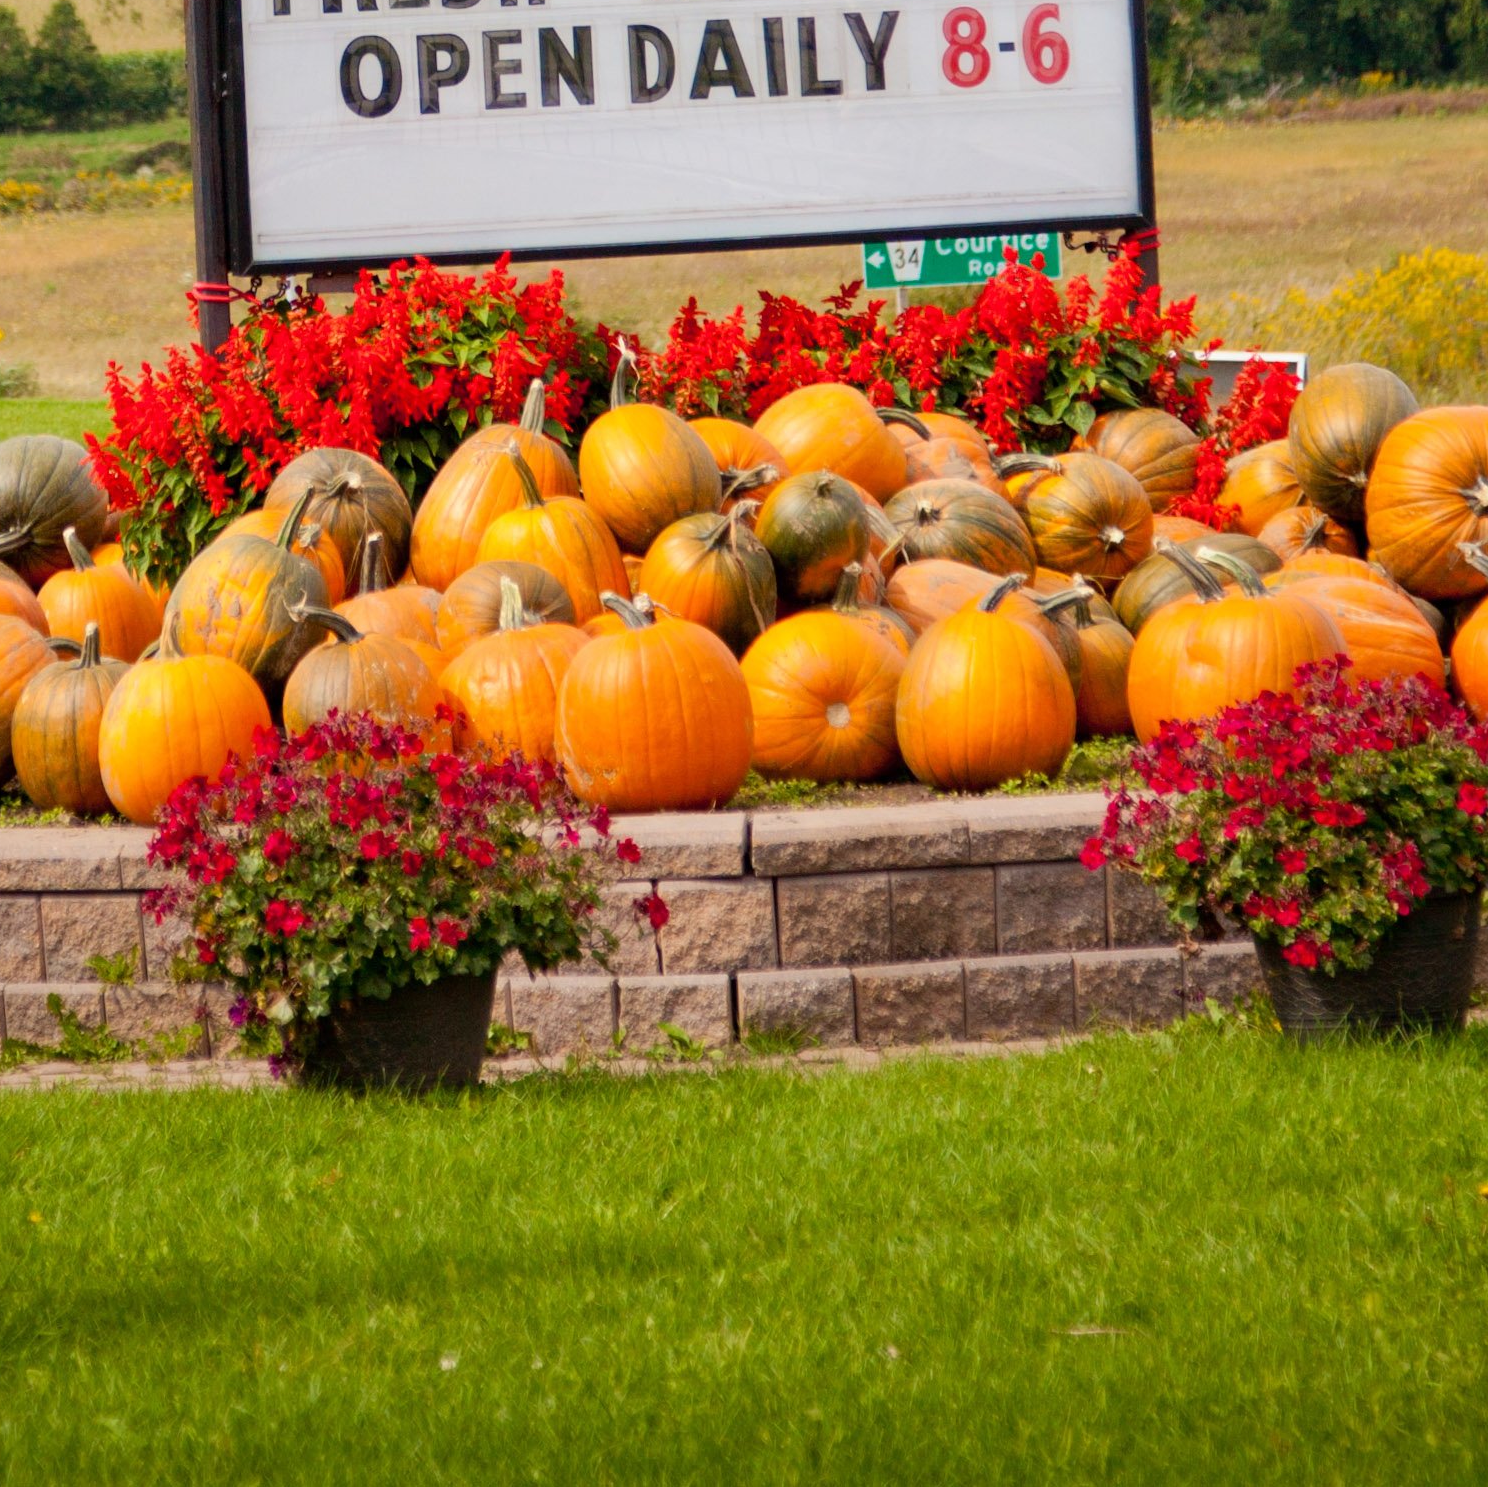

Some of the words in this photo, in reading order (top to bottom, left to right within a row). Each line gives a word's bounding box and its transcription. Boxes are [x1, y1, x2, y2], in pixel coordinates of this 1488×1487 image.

[339, 25, 595, 119] OPEN
[628, 11, 900, 104] DAILY
[942, 3, 1070, 88] 8-6
[894, 248, 920, 270] 34
